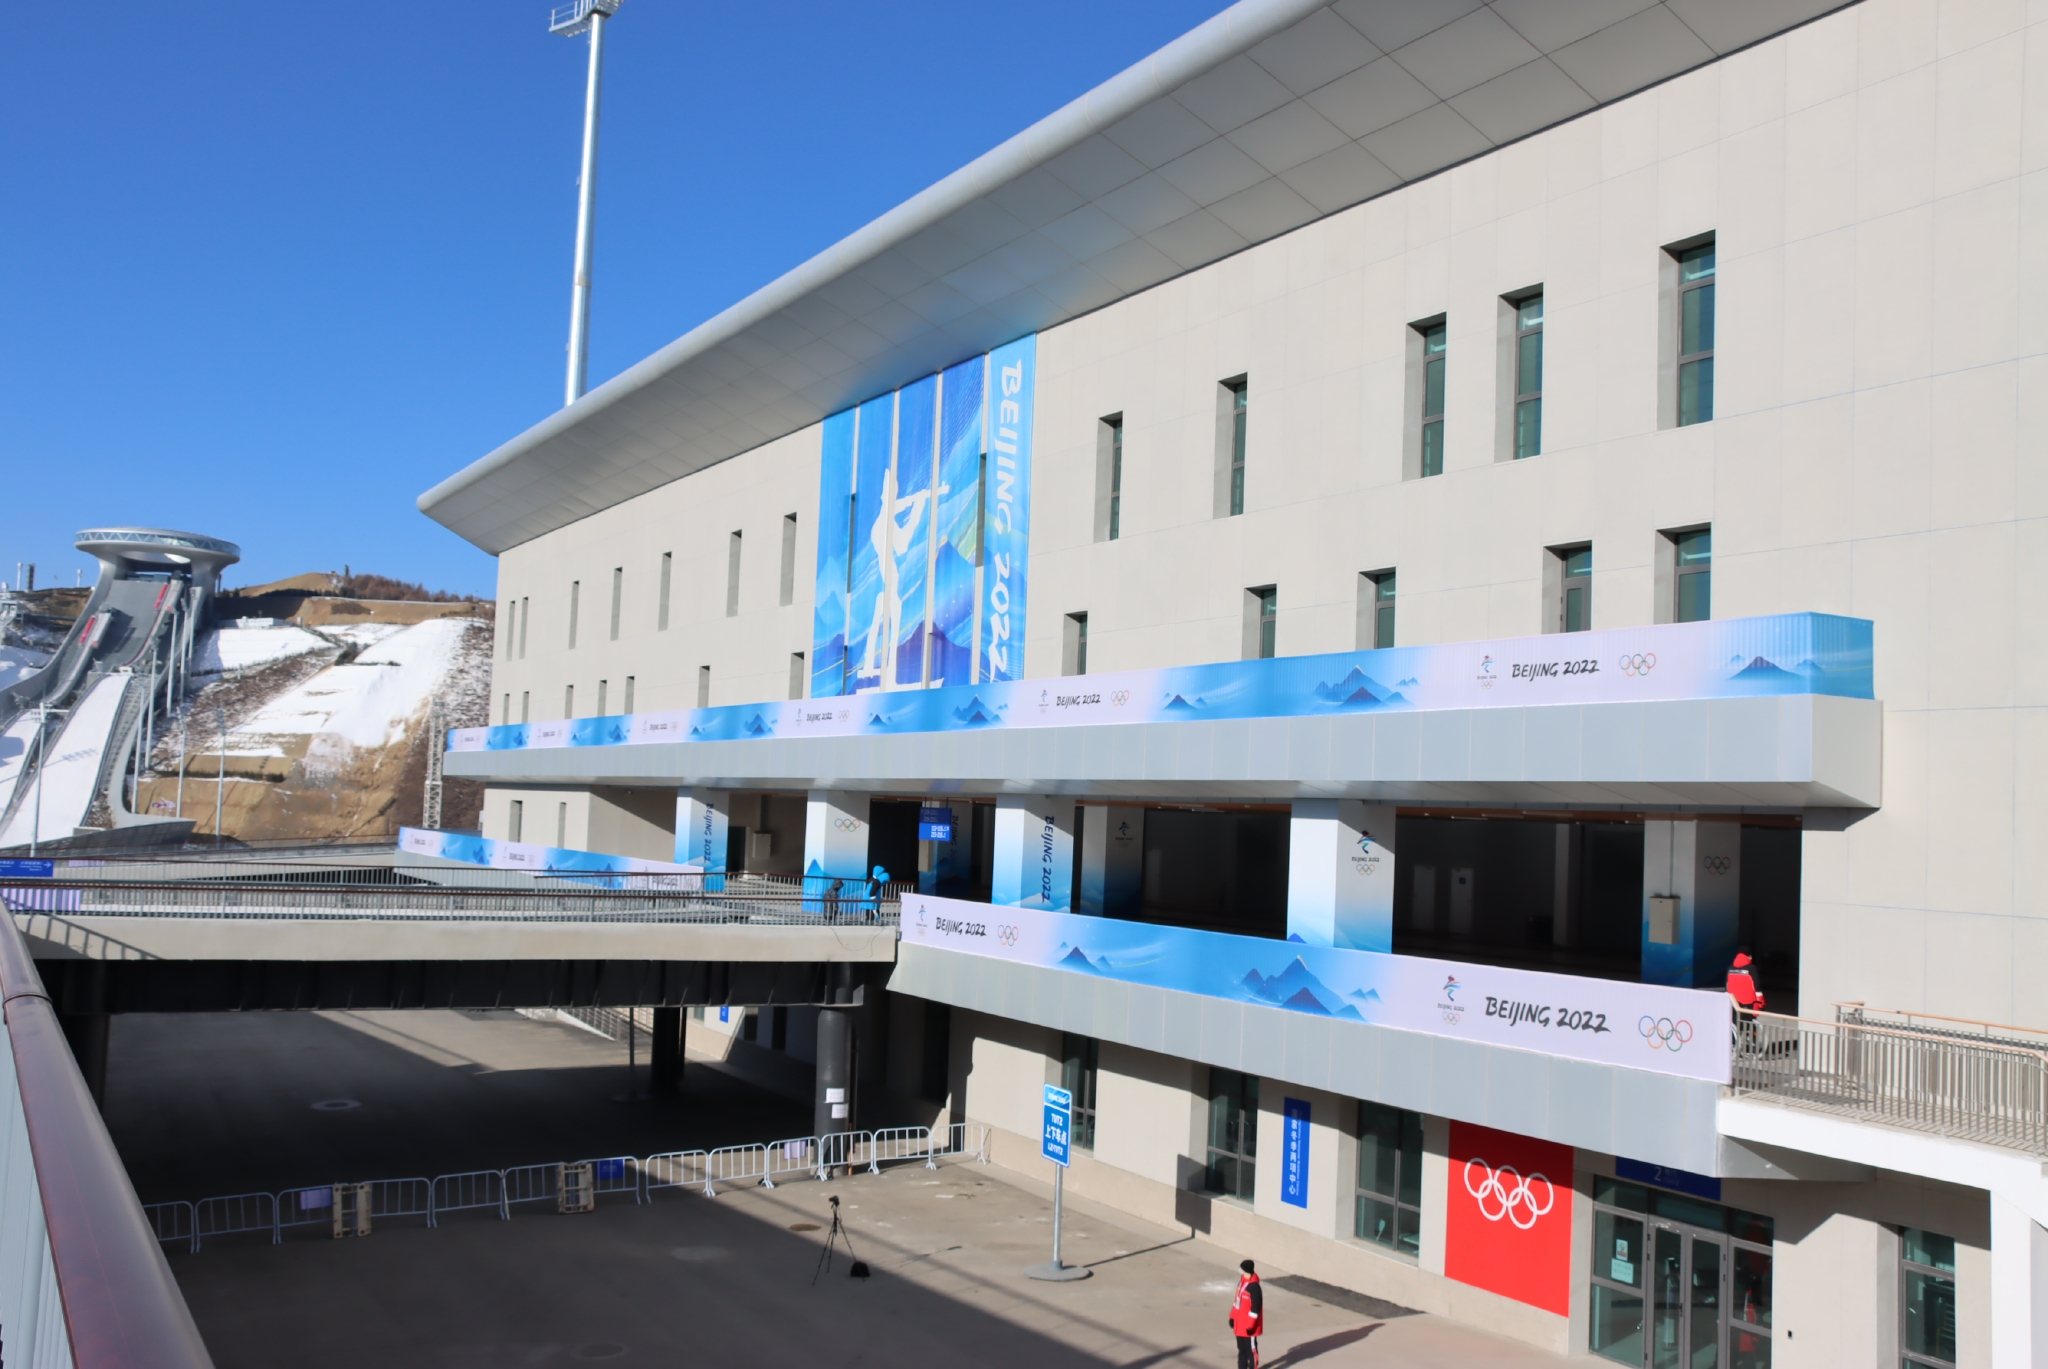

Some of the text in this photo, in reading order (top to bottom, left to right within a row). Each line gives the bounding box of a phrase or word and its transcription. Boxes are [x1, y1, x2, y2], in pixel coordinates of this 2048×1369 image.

[988, 359, 1022, 683] BEIJING 2022
[1512, 660, 1600, 682] BEIJING 2022
[1056, 693, 1101, 709] BEIJING 2022
[703, 802, 714, 863] BEIJING 2022
[1041, 815, 1054, 904] BEIJING 2022
[935, 916, 987, 937] BEIJING 2022
[1485, 996, 1612, 1034] BEIJING 2022
